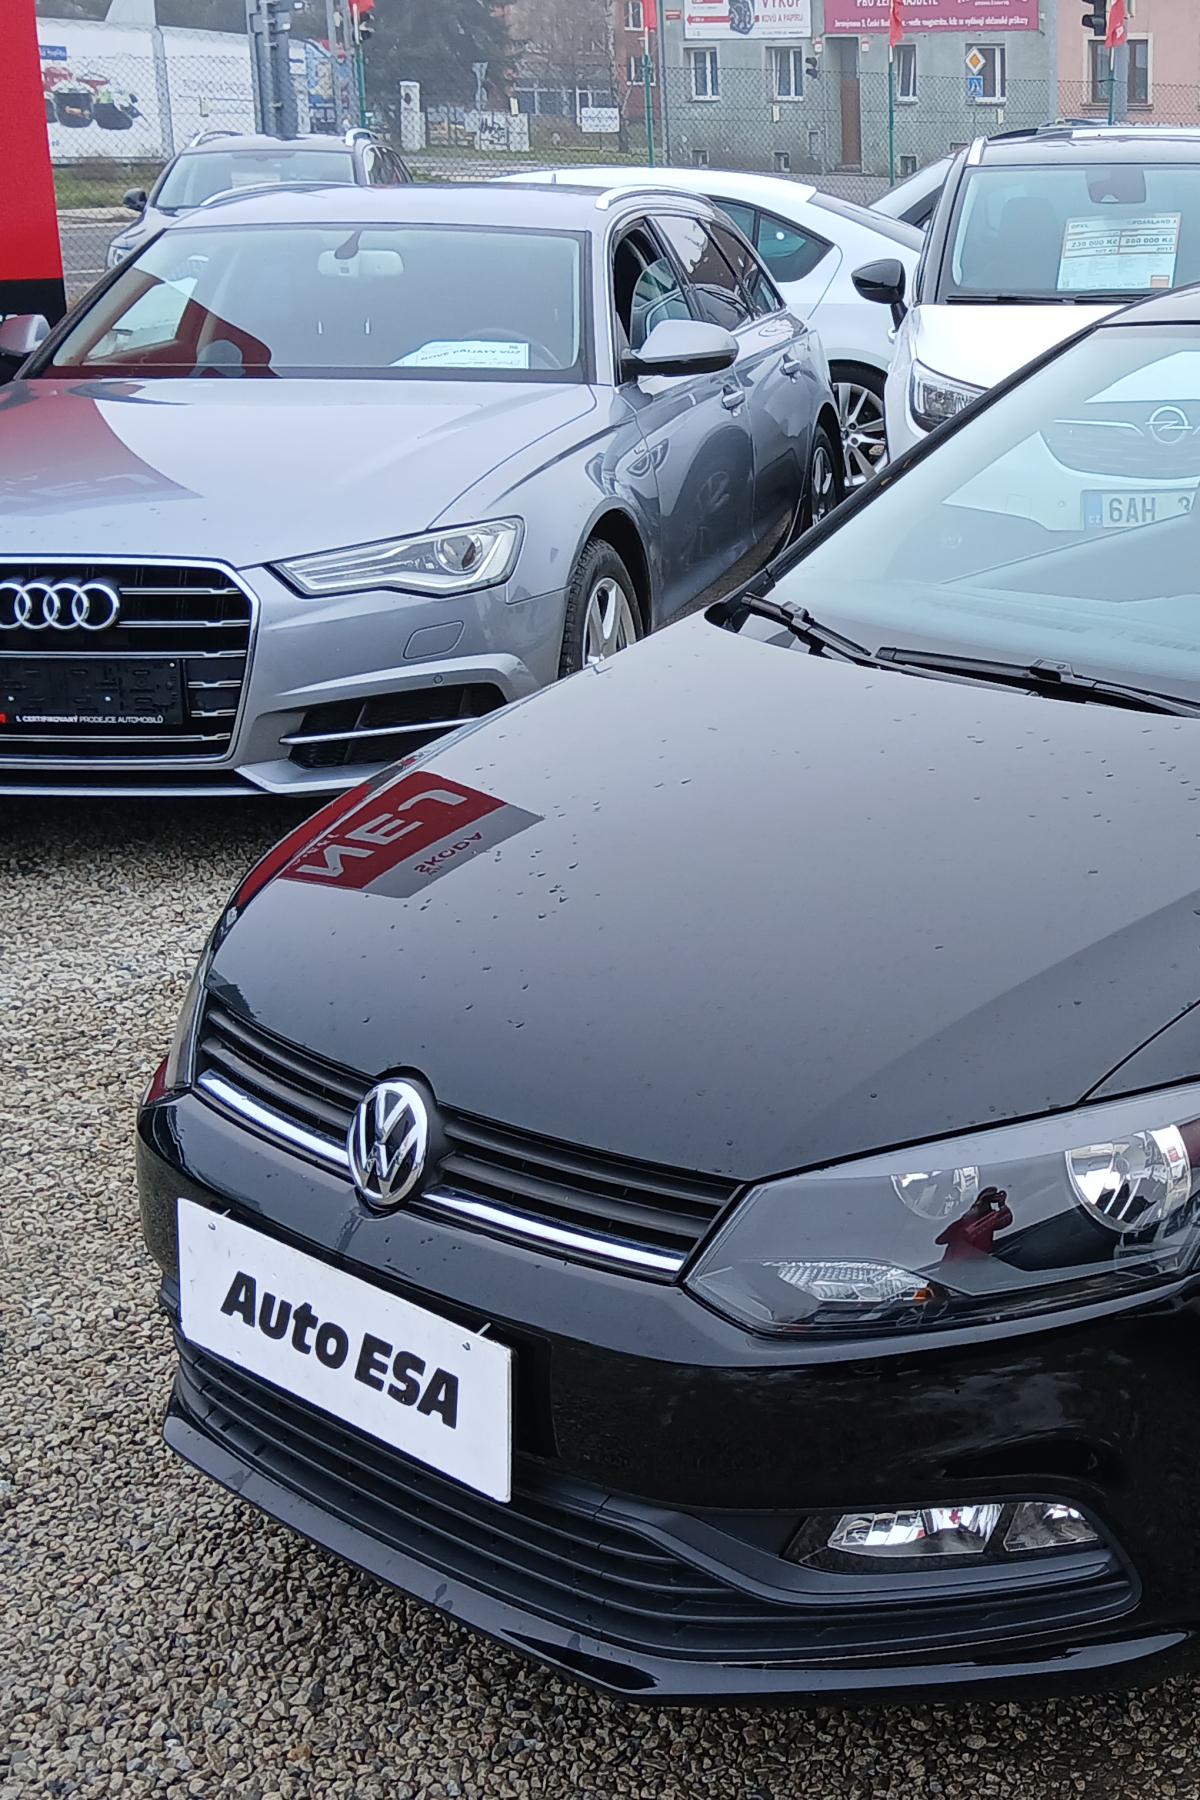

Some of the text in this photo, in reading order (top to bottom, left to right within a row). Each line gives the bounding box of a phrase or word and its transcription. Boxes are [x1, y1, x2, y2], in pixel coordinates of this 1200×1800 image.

[1108, 497, 1157, 524] 6AH
[79, 714, 117, 724] PRODEJCE
[118, 714, 164, 724] AUTOMOBILŮ
[220, 1270, 460, 1430] Auto ESA
